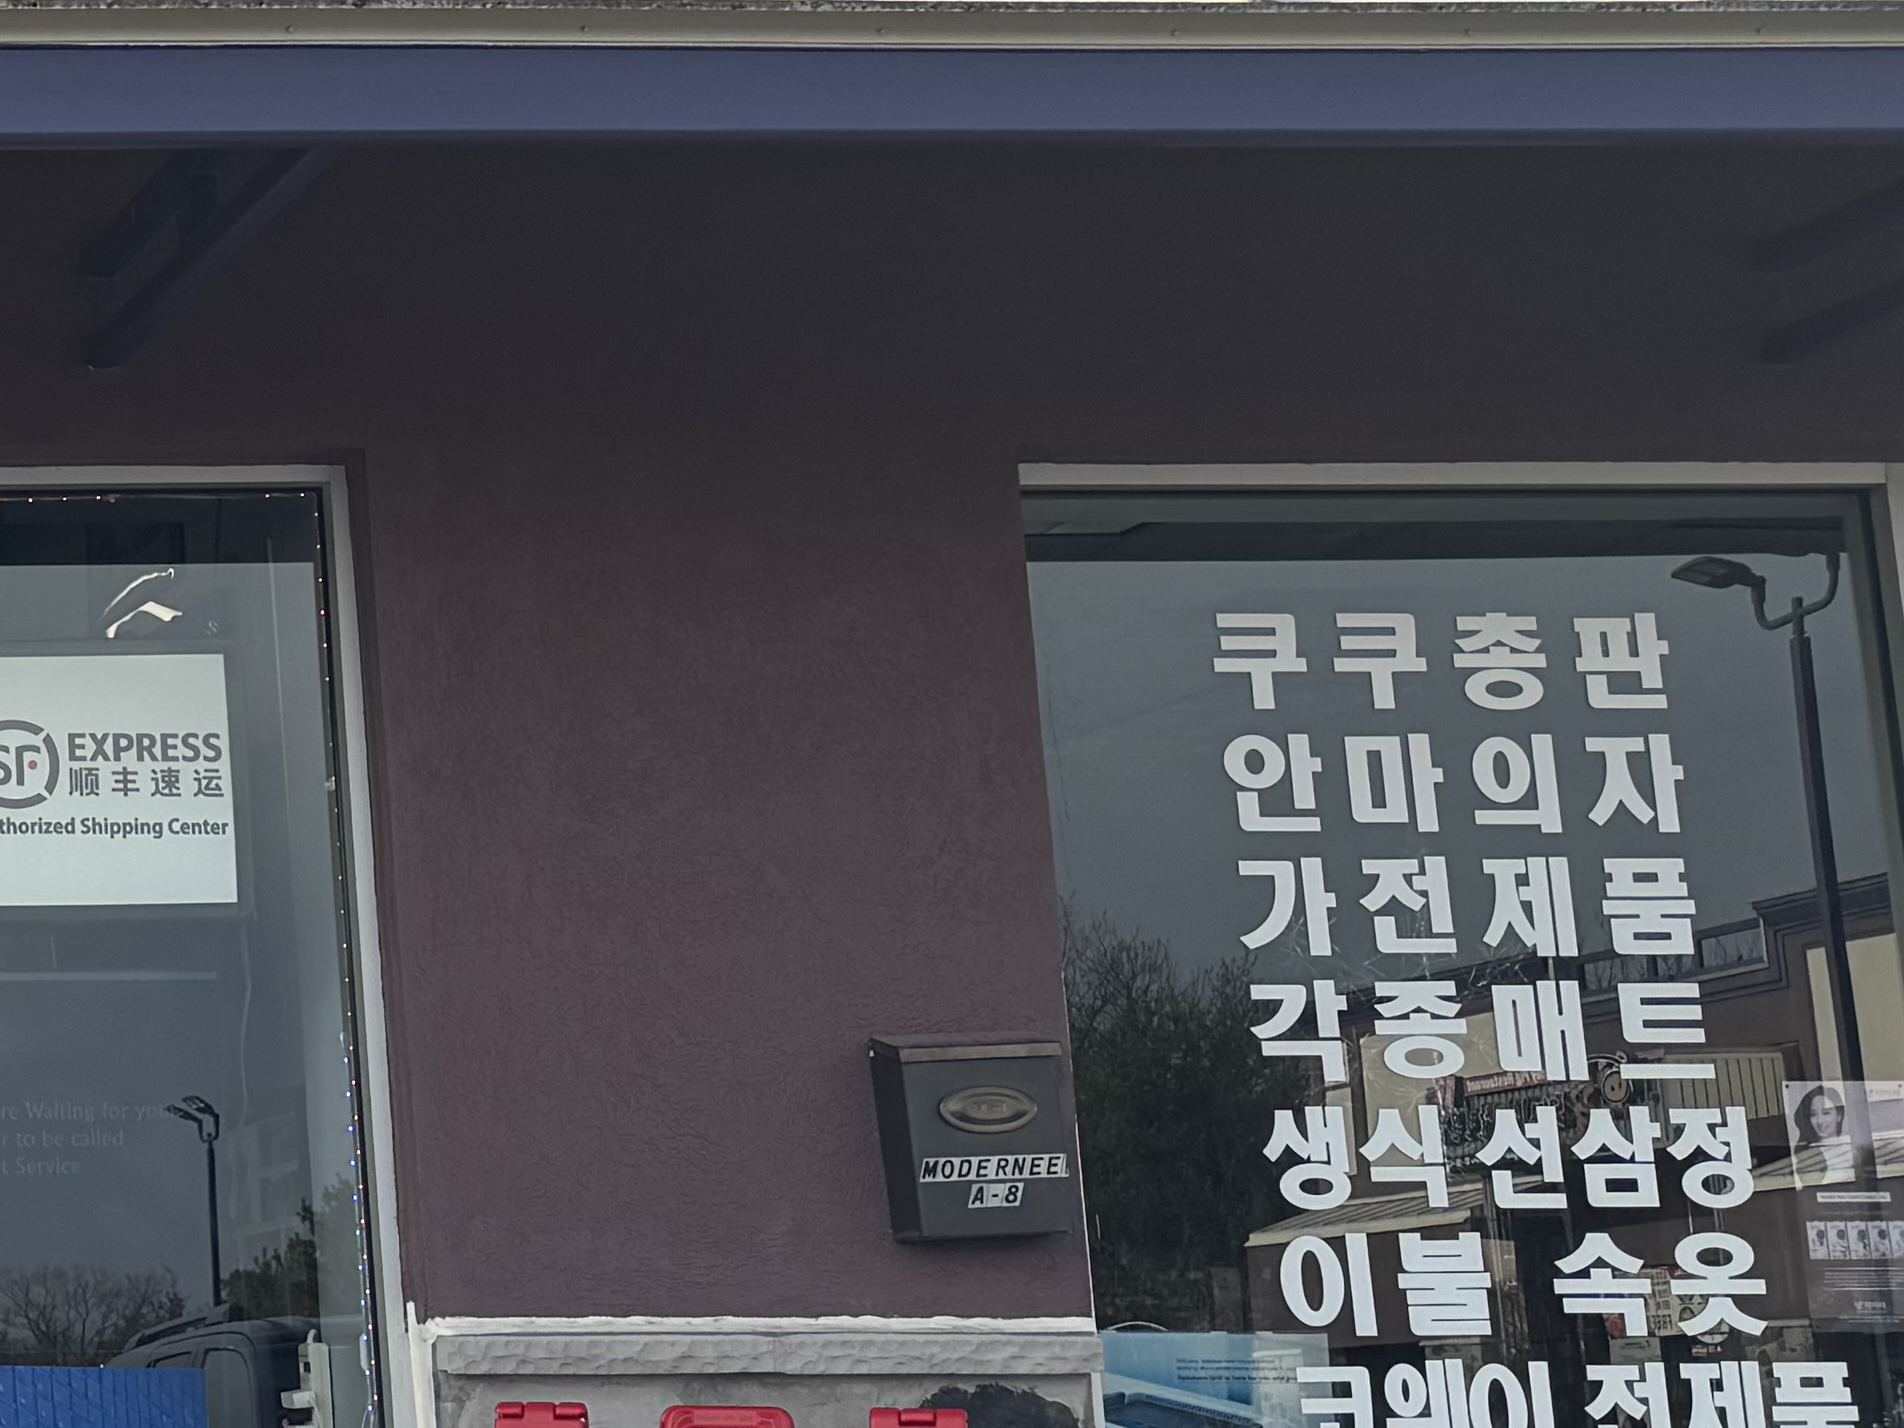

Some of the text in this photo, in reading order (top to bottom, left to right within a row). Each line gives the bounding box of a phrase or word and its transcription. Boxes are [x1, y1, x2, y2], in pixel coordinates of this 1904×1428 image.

[68, 732, 222, 763] EXPRESS
[80, 817, 164, 839] Shipping
[167, 818, 229, 836] Center
[1263, 1104, 1755, 1211] 생식 선삼정
[1279, 1232, 1768, 1337] 이불 속옷
